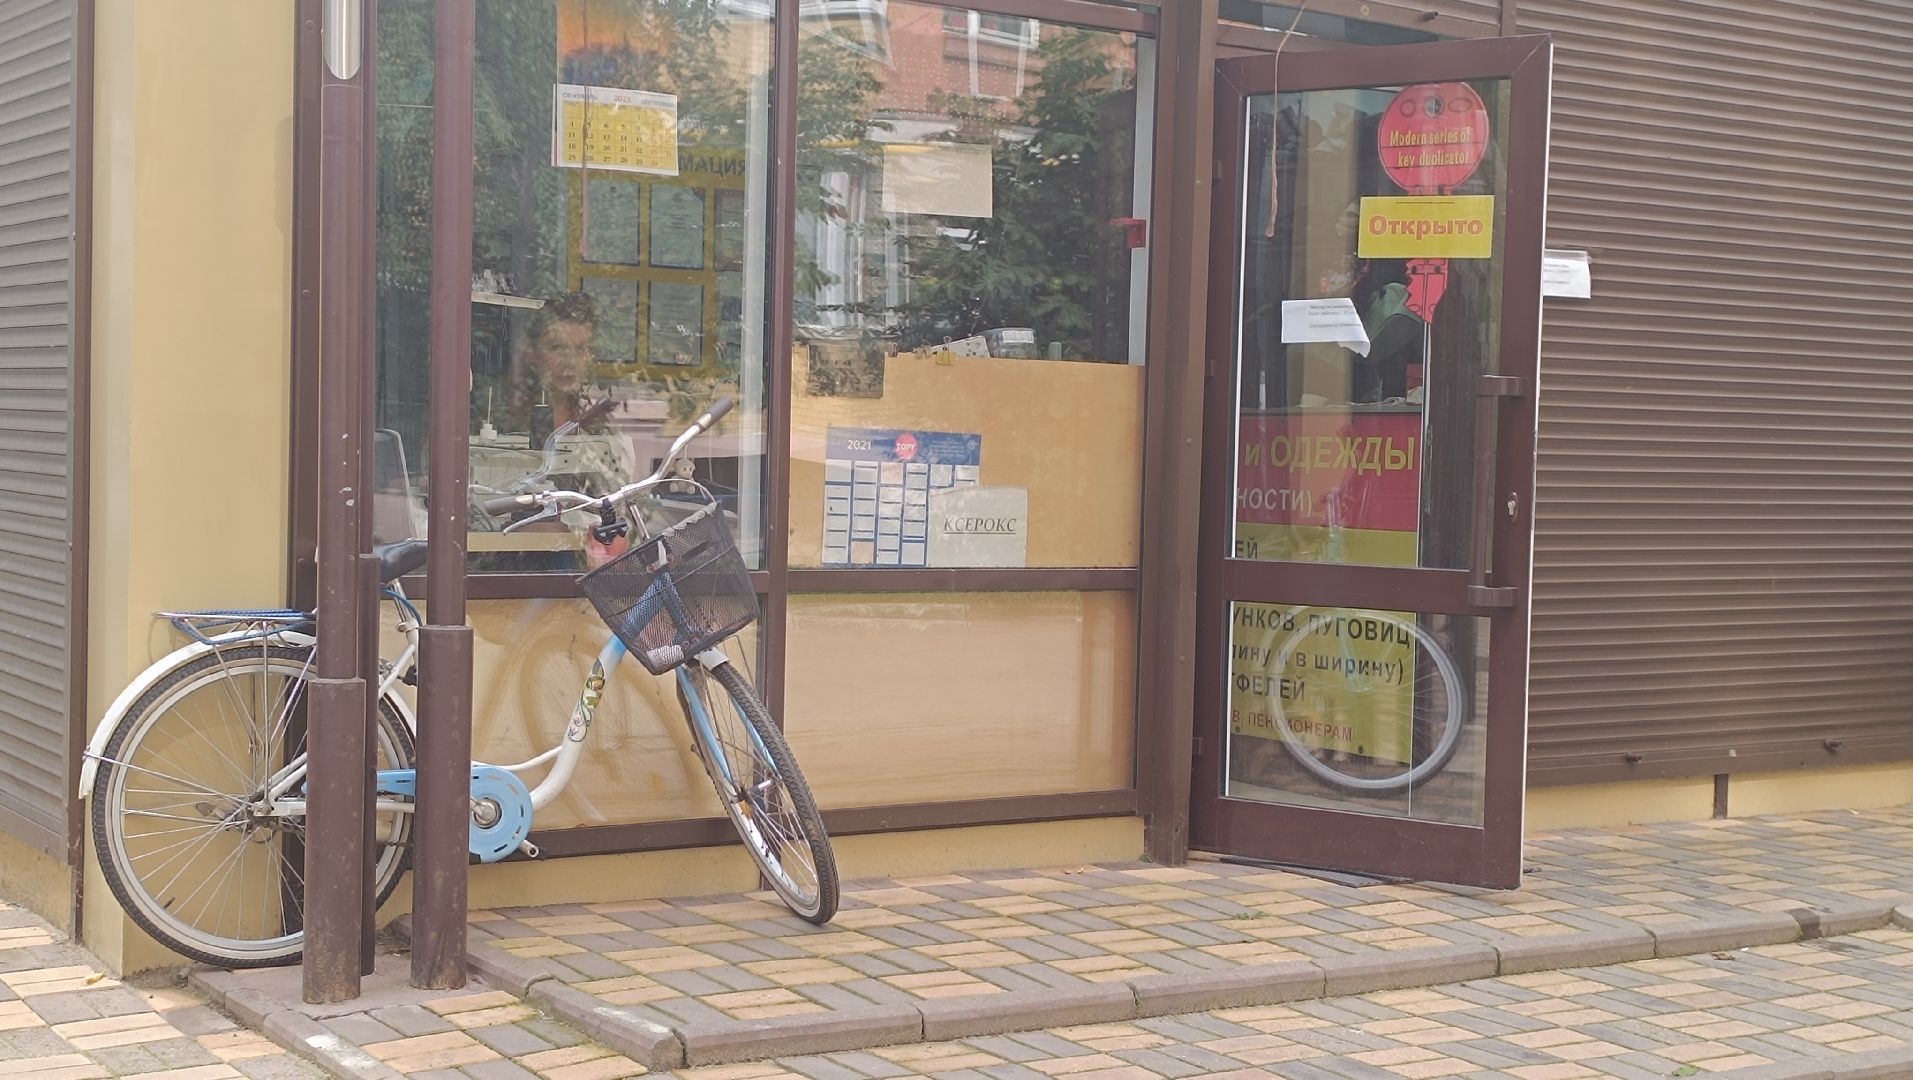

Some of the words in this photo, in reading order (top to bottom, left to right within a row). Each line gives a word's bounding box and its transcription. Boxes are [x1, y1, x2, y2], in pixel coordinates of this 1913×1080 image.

[1390, 130, 1427, 146] Modern
[1429, 128, 1458, 144] series
[1460, 126, 1471, 142] of
[1419, 150, 1470, 168] duplicator
[1369, 215, 1483, 240] Открыто
[847, 439, 872, 450] 2021
[1245, 443, 1260, 466] и
[1271, 435, 1416, 476] ОДЕЖДЫ
[943, 517, 1017, 532] КСЕРОКС
[1309, 613, 1410, 649] ПУГОВИЦ
[1314, 654, 1404, 685] ширину)
